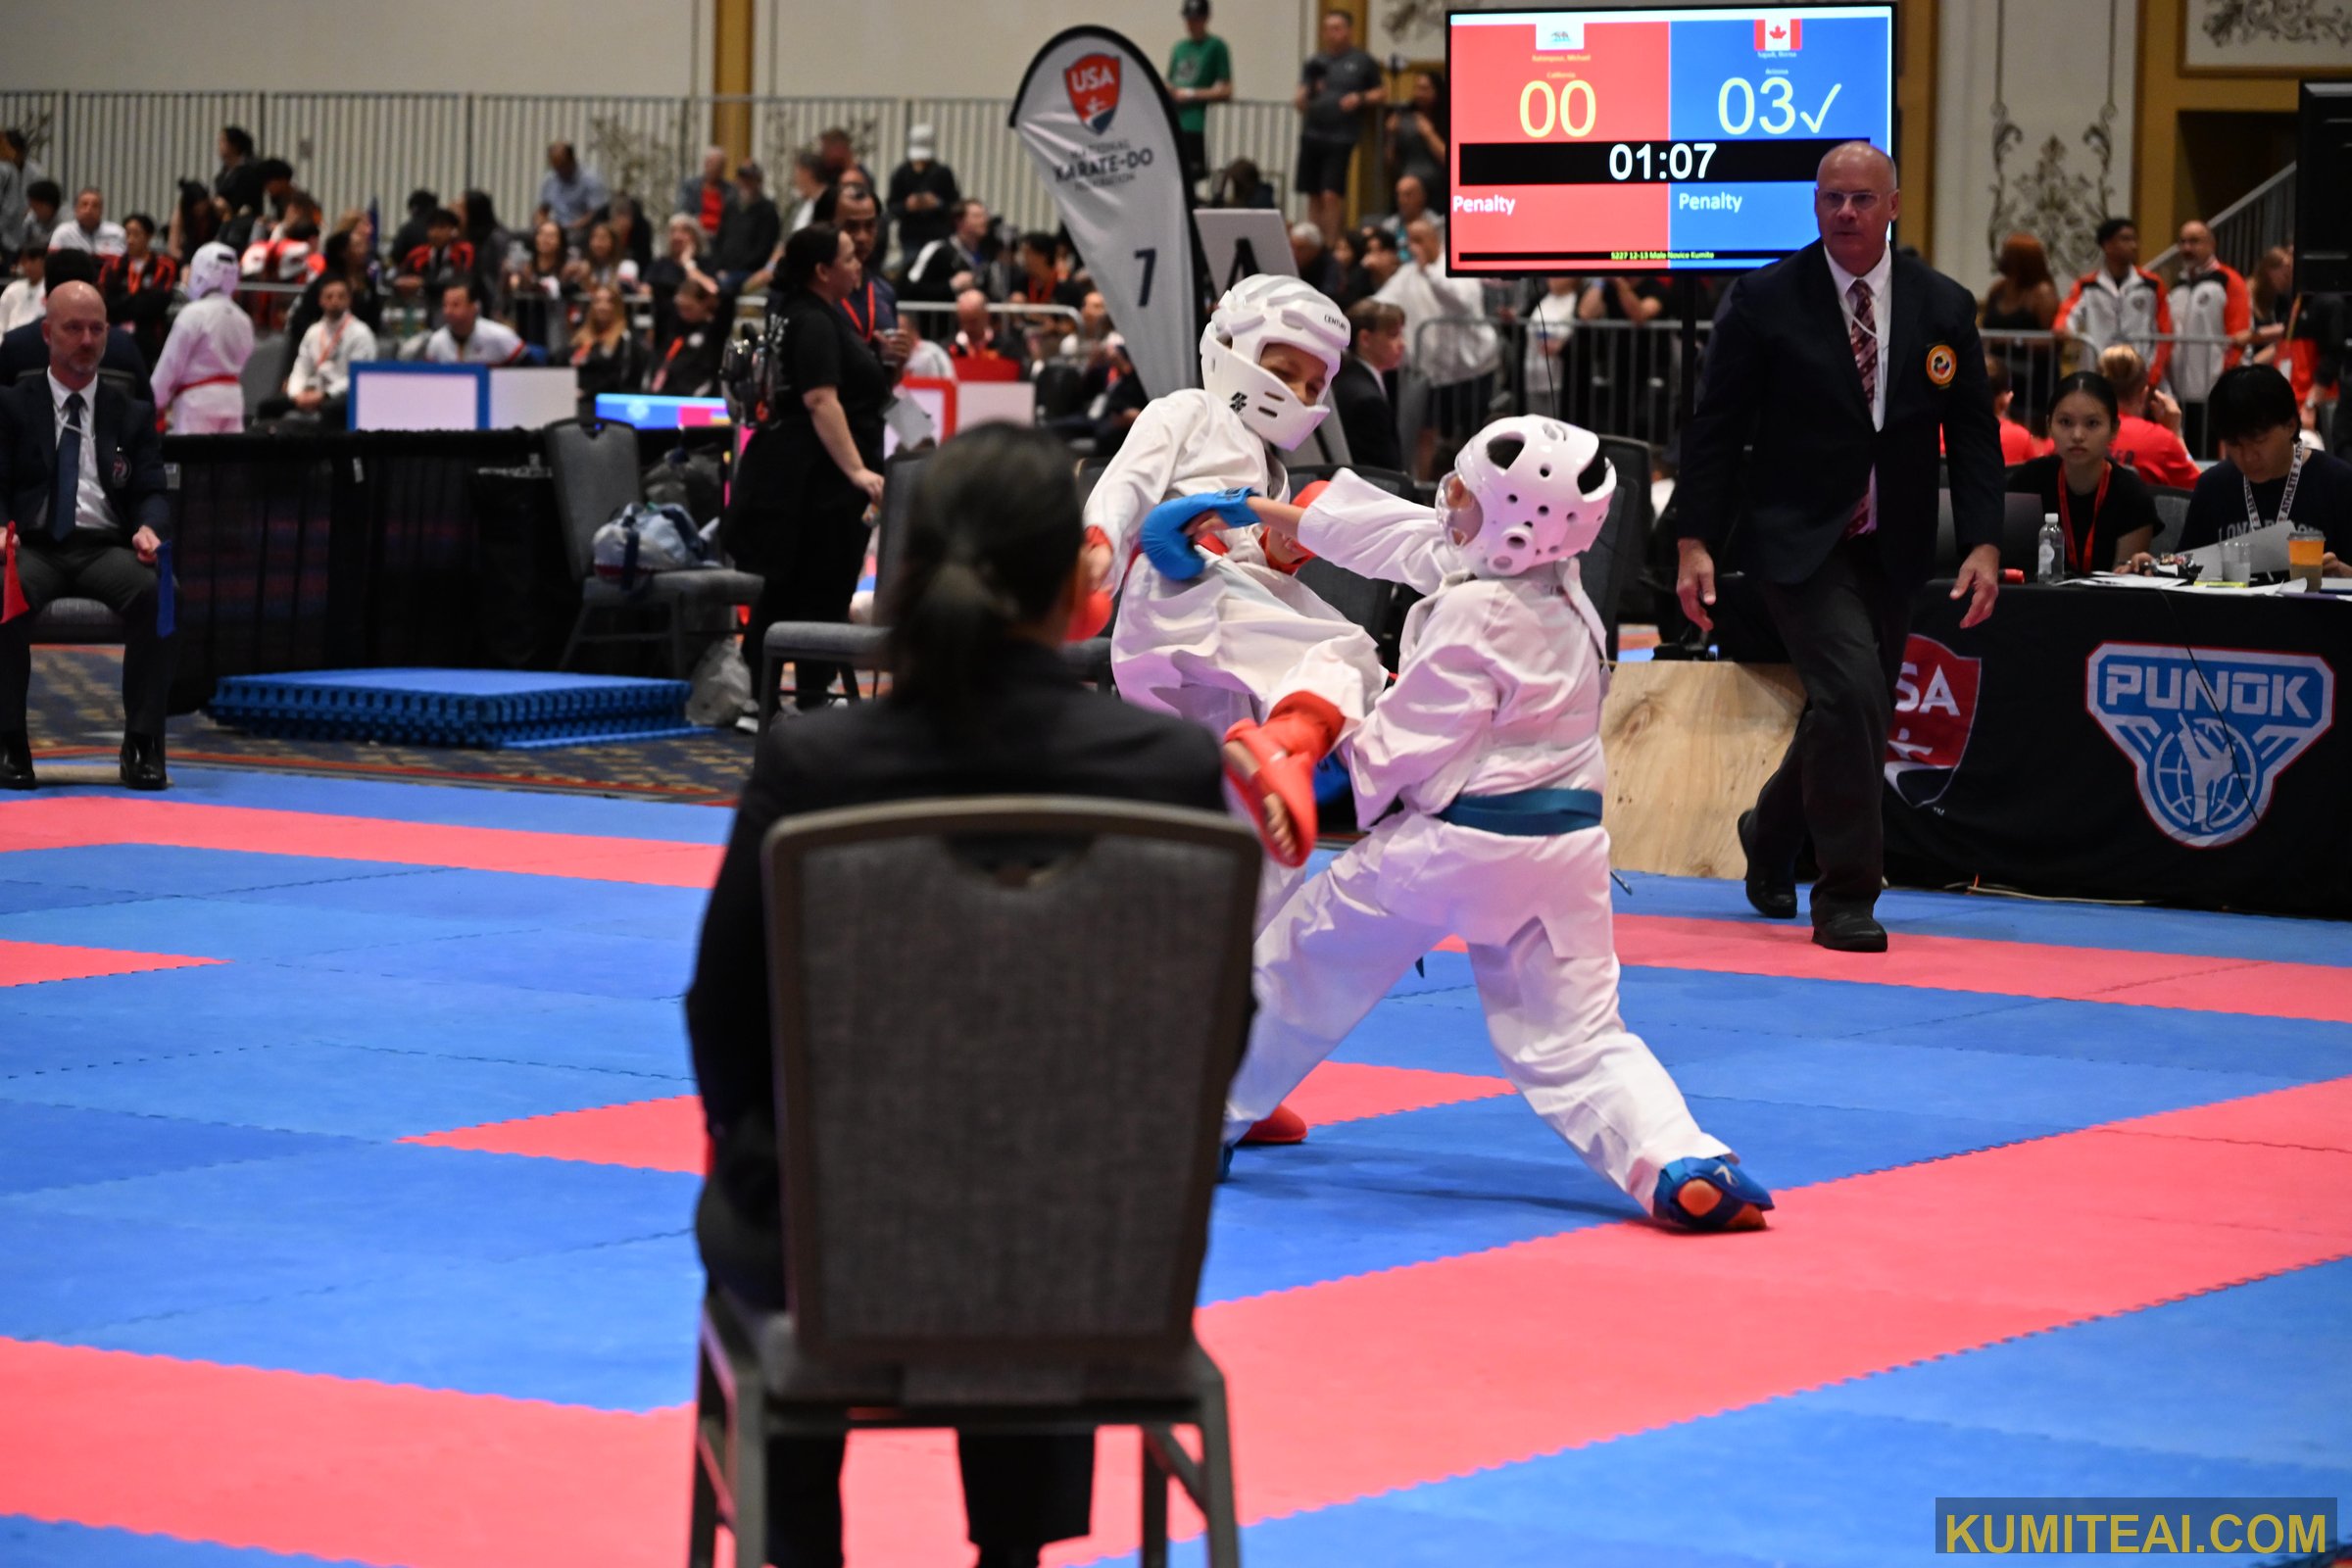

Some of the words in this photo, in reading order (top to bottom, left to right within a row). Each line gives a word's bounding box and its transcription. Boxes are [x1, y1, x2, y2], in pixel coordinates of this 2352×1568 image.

[1071, 67, 1114, 92] USA
[1519, 79, 1596, 137] 00
[1718, 76, 1796, 135] 03
[1608, 142, 1717, 180] 01:07
[1452, 195, 1515, 216] Penalty
[1679, 192, 1742, 213] Penalty
[1134, 247, 1156, 308] 7
[2280, 472, 2299, 514] ATHLETE
[1895, 663, 1960, 716] SA
[2106, 663, 2311, 718] PUNOK
